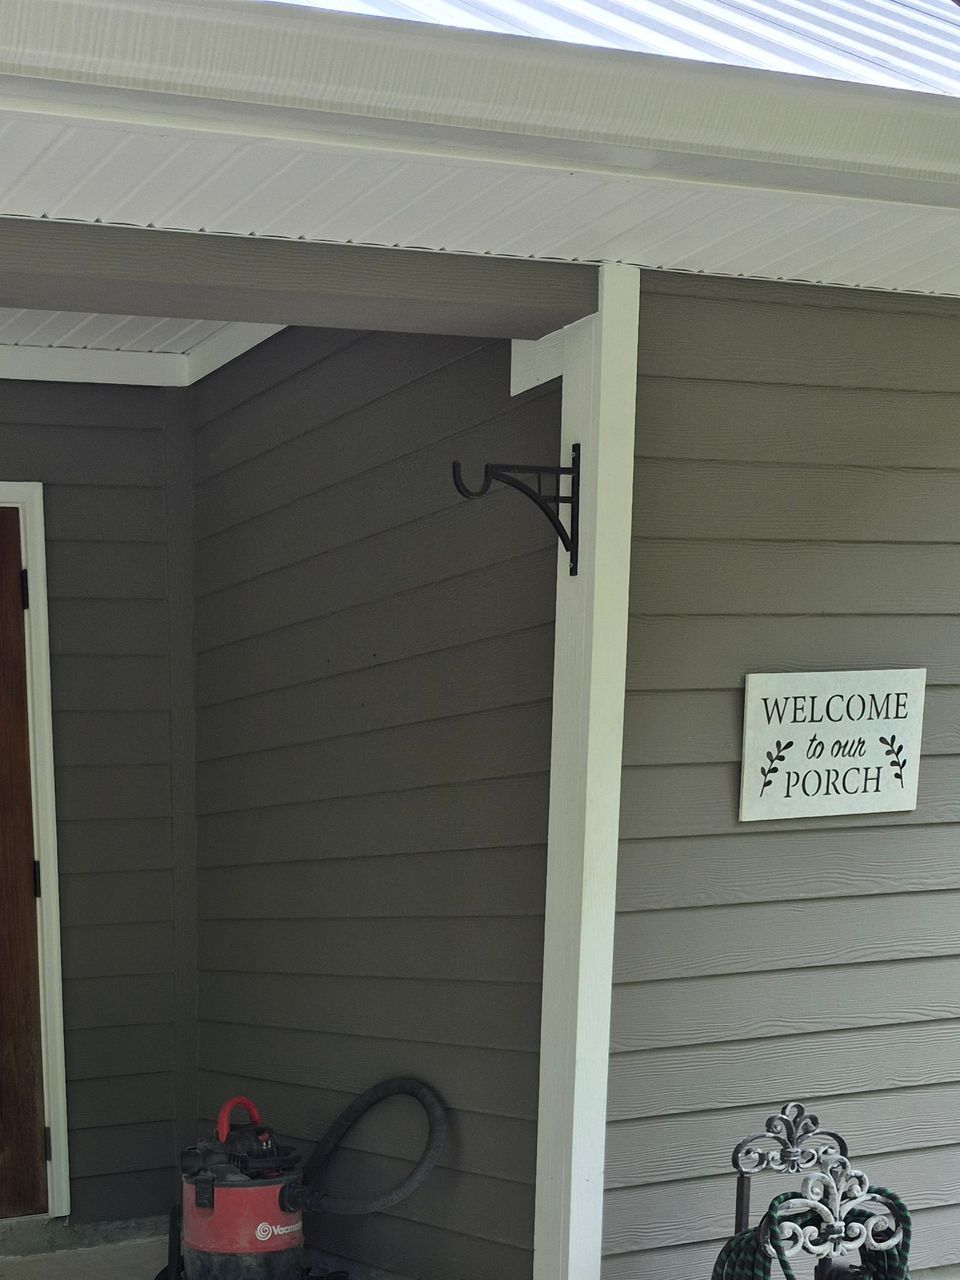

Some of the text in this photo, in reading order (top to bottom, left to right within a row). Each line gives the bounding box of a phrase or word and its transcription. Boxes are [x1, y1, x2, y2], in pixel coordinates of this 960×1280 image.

[761, 692, 909, 725] WELCOME
[806, 733, 867, 760] to our
[784, 766, 884, 798] PORCH
